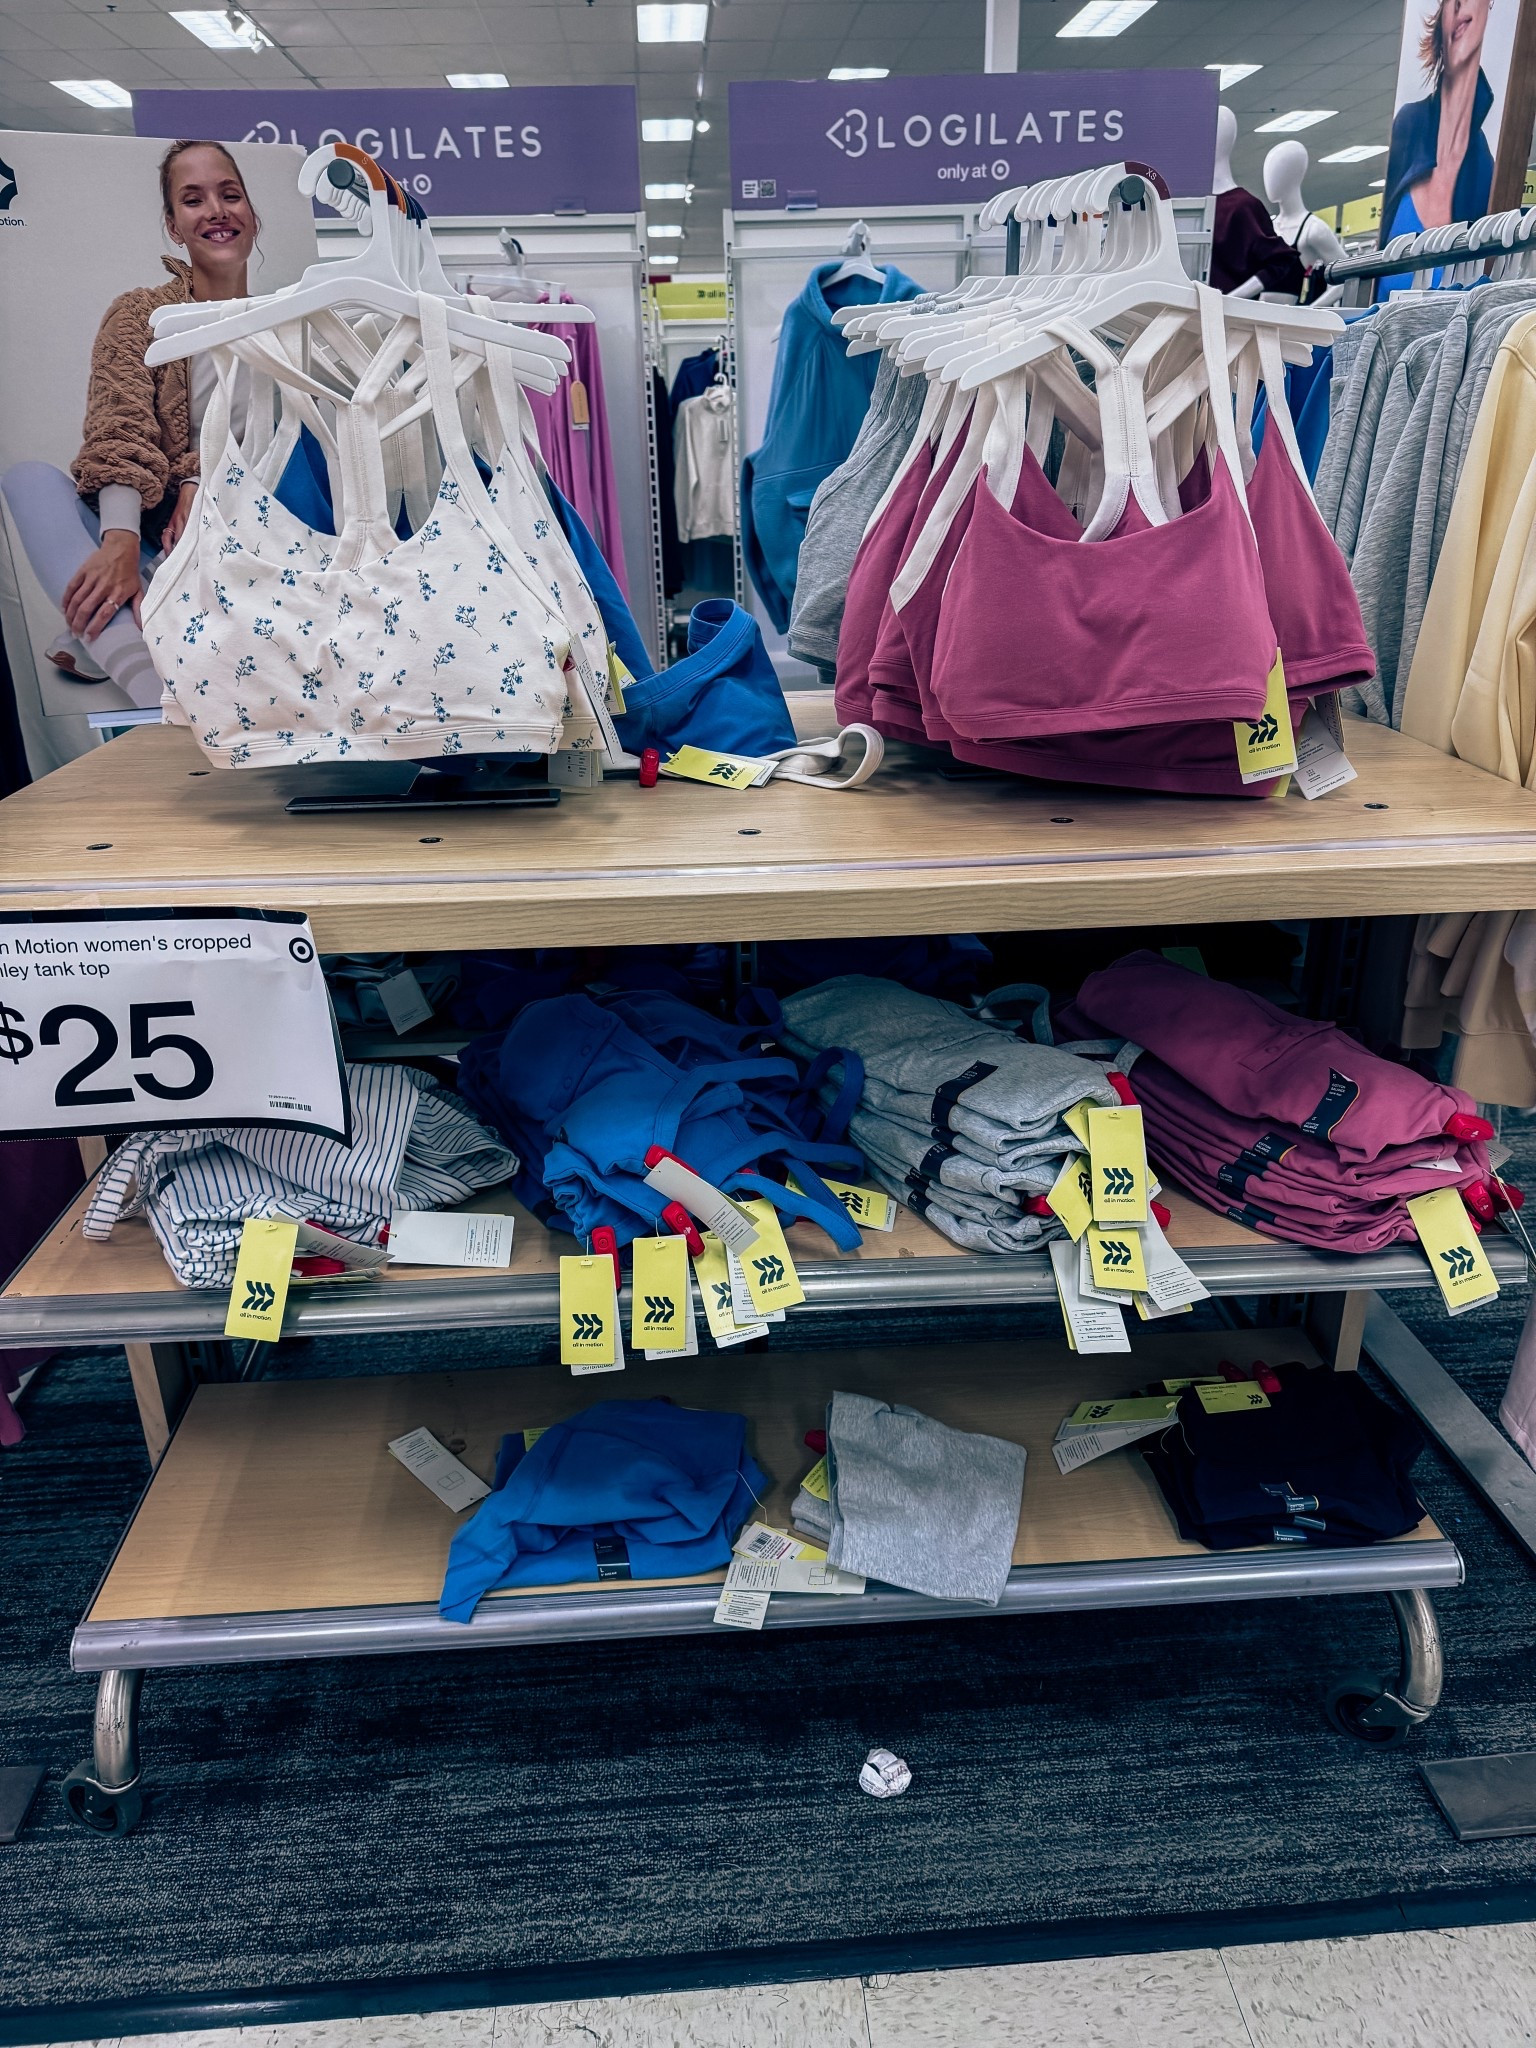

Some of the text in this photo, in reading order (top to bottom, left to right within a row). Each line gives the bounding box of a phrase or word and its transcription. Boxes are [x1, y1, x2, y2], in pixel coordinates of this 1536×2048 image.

[937, 163, 987, 182] only at
[1145, 168, 1157, 181] XS
[1262, 742, 1281, 751] motion
[15, 938, 78, 954] Motion
[84, 935, 168, 952] women's
[173, 933, 252, 953] cropped
[34, 961, 75, 977] tank
[79, 961, 110, 978] top
[0, 1000, 214, 1107] $25
